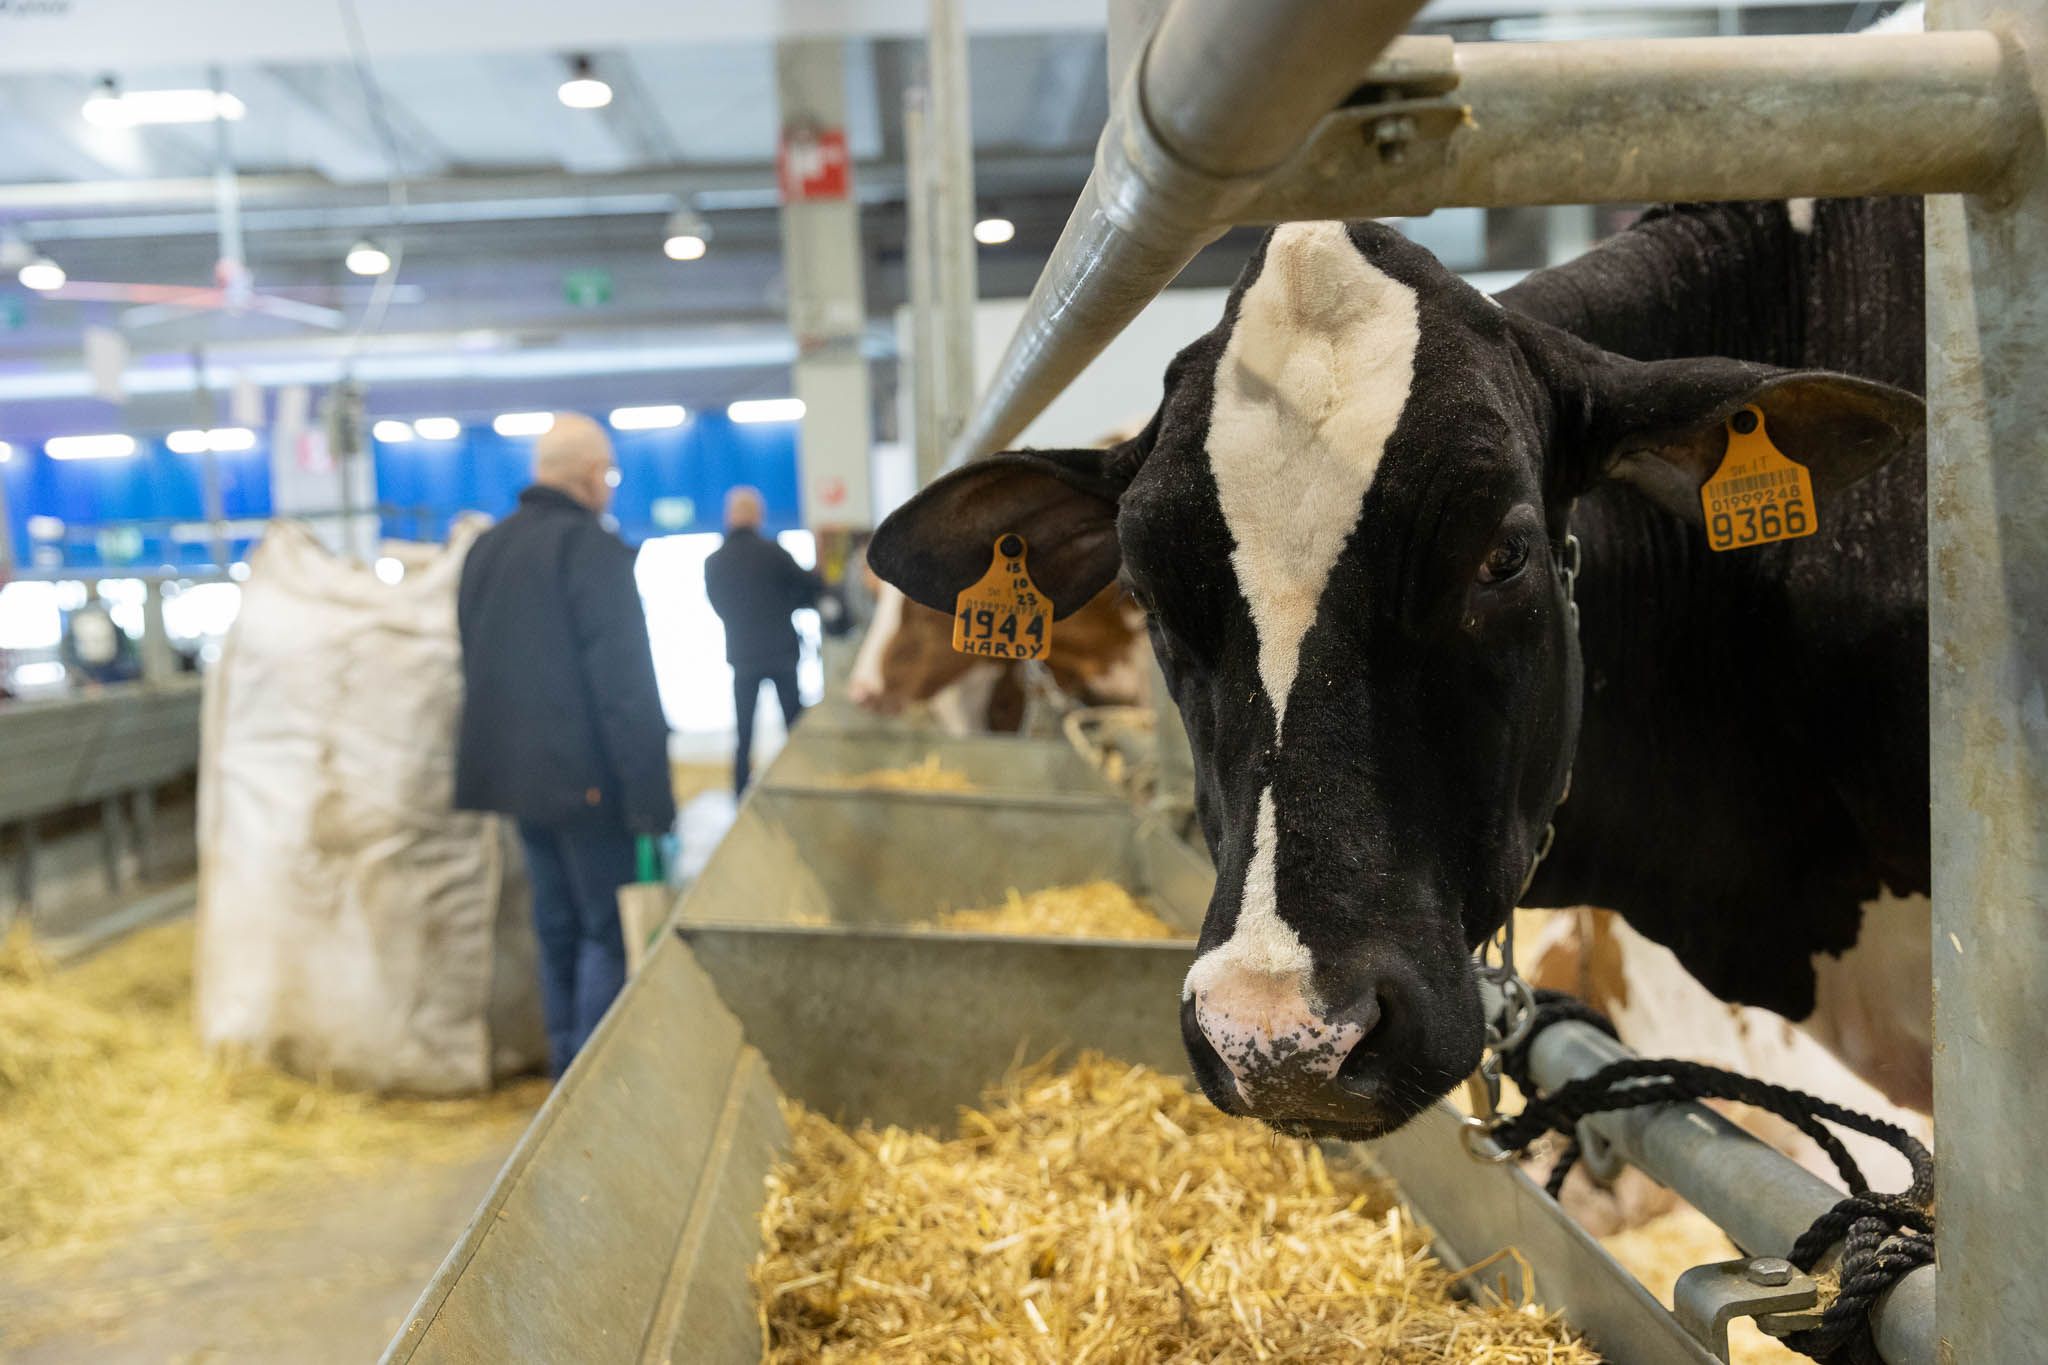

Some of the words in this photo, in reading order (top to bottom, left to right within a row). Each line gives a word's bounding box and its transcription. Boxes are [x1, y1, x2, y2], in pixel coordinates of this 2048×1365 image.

[1712, 484, 1801, 512] 01999248
[1712, 499, 1806, 547] 9366
[1006, 563, 1021, 573] 15
[1014, 578, 1028, 589] 10
[1017, 592, 1037, 606] 23
[960, 607, 1044, 644] 1944
[964, 640, 1043, 658] HARDY
